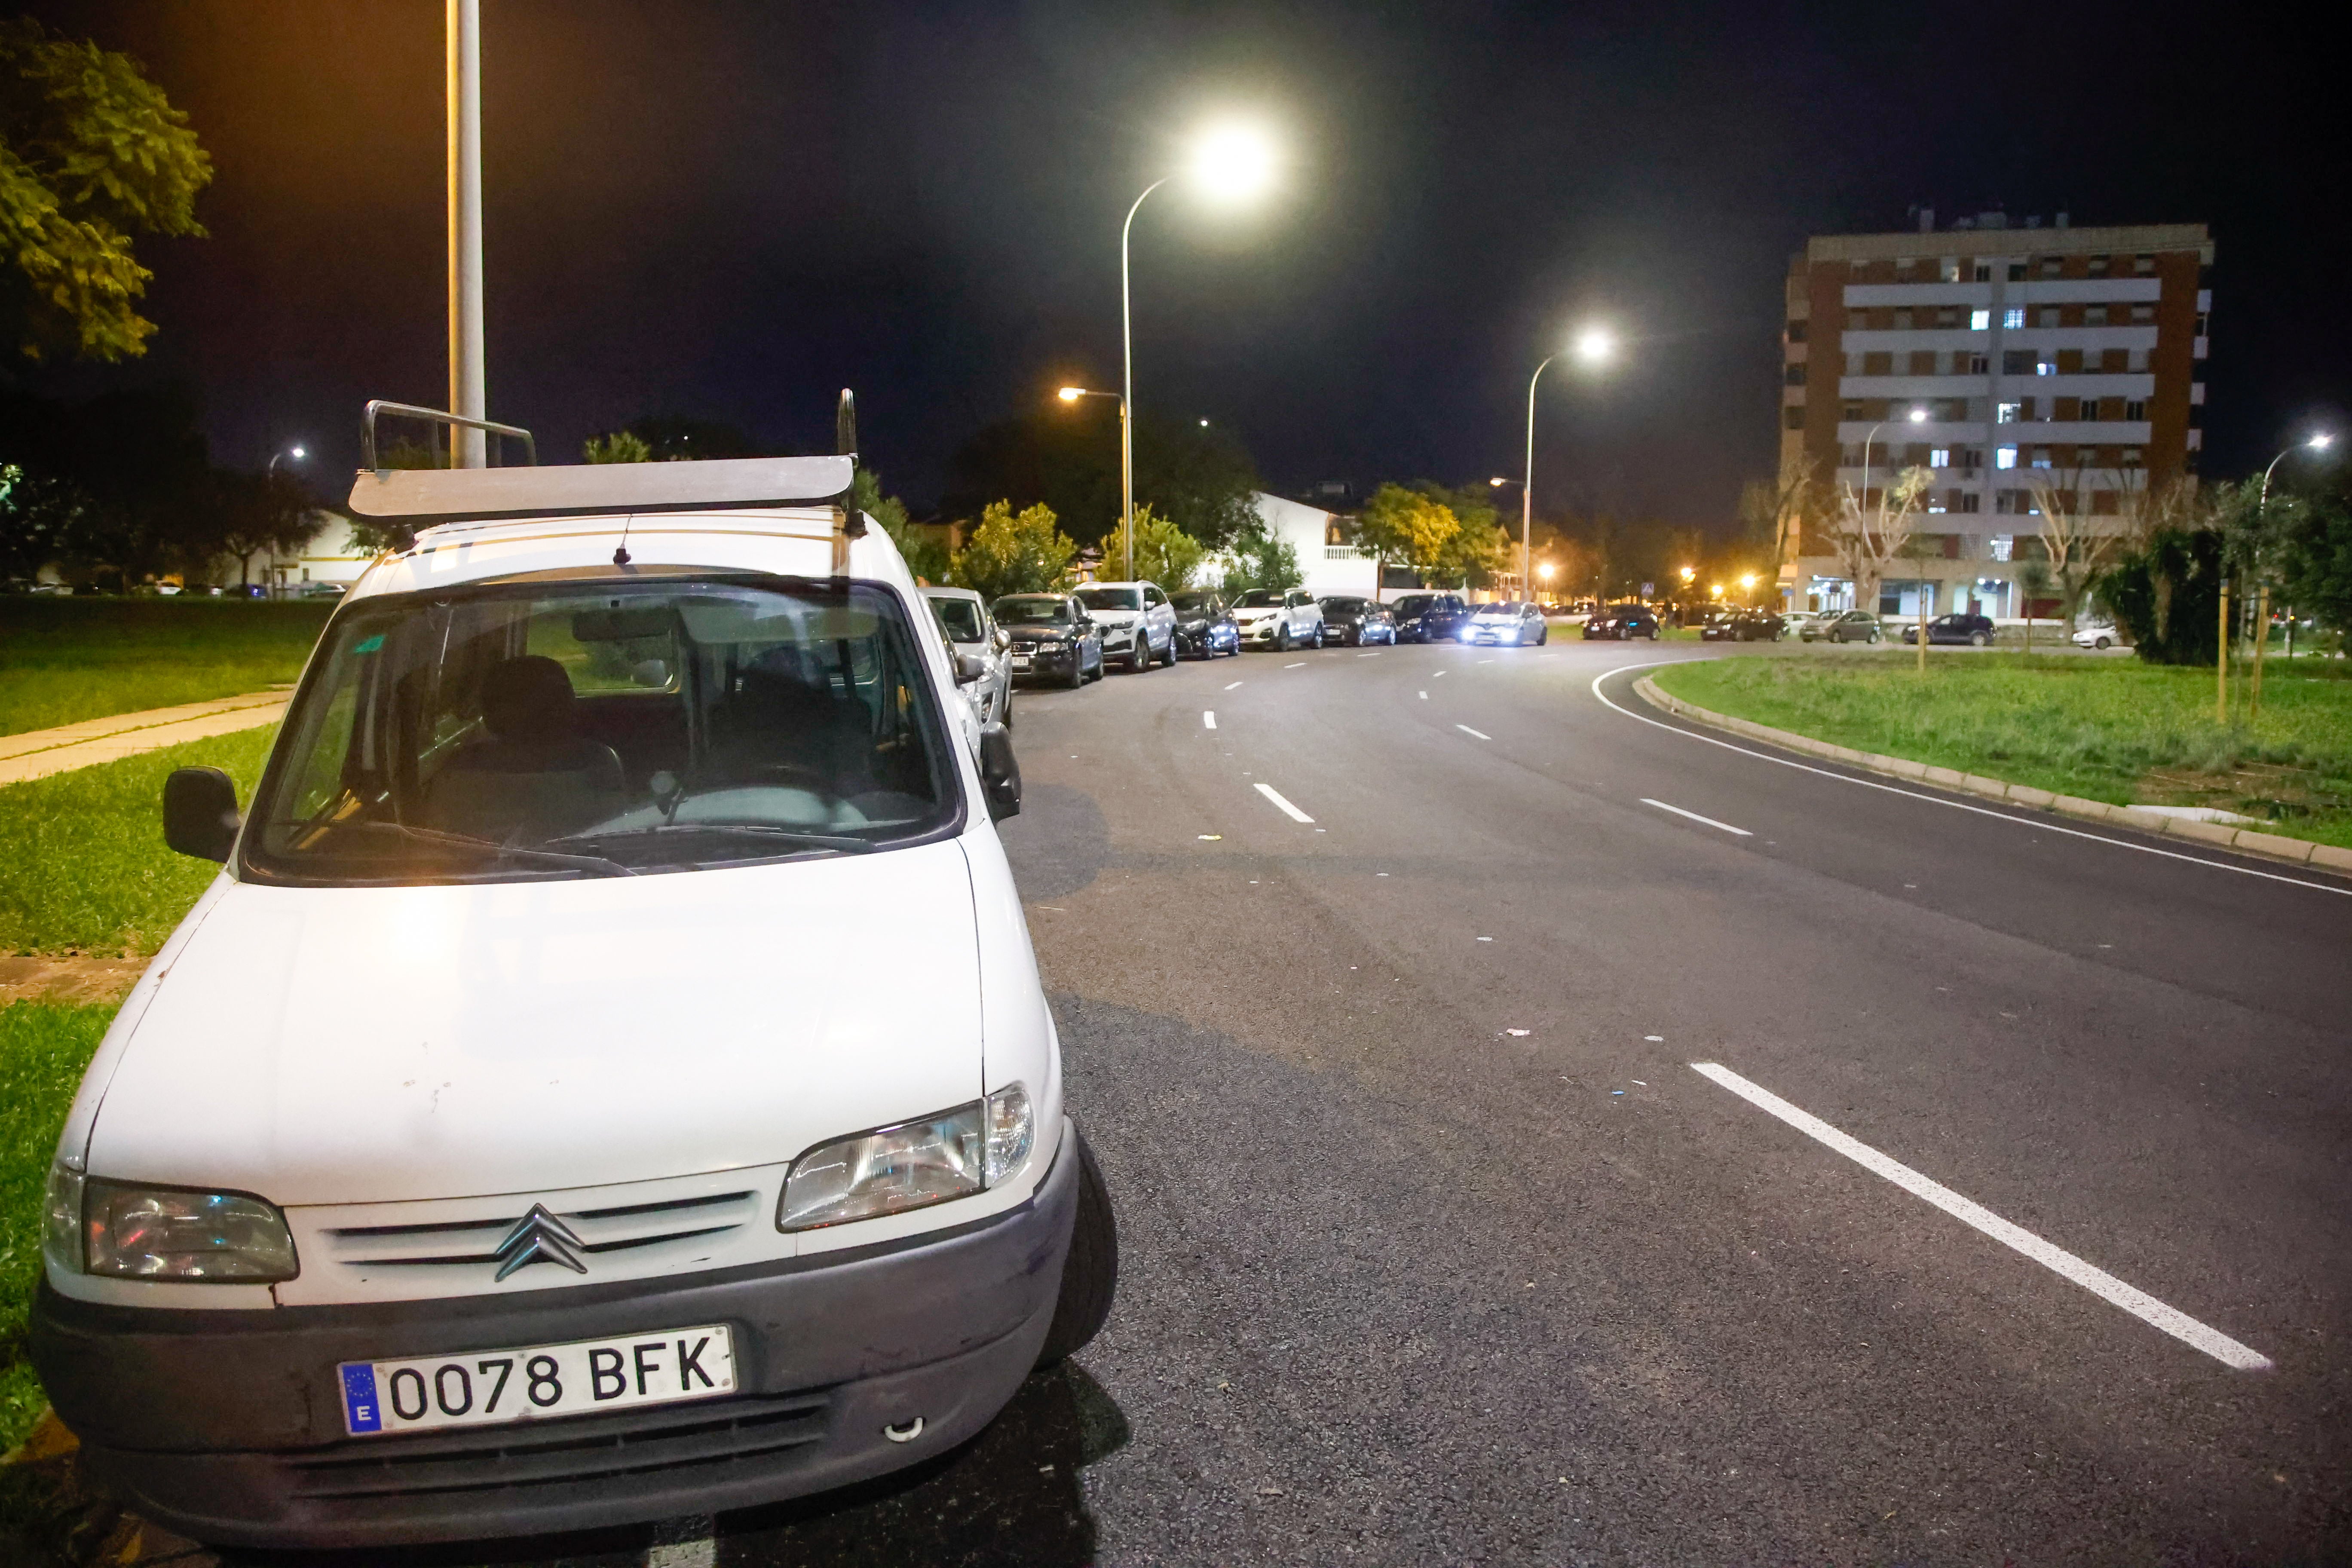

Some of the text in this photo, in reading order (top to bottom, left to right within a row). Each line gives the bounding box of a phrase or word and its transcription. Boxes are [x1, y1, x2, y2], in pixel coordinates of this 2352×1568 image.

[390, 1337, 714, 1420] 0078 BFK
[357, 1406, 372, 1421] E
